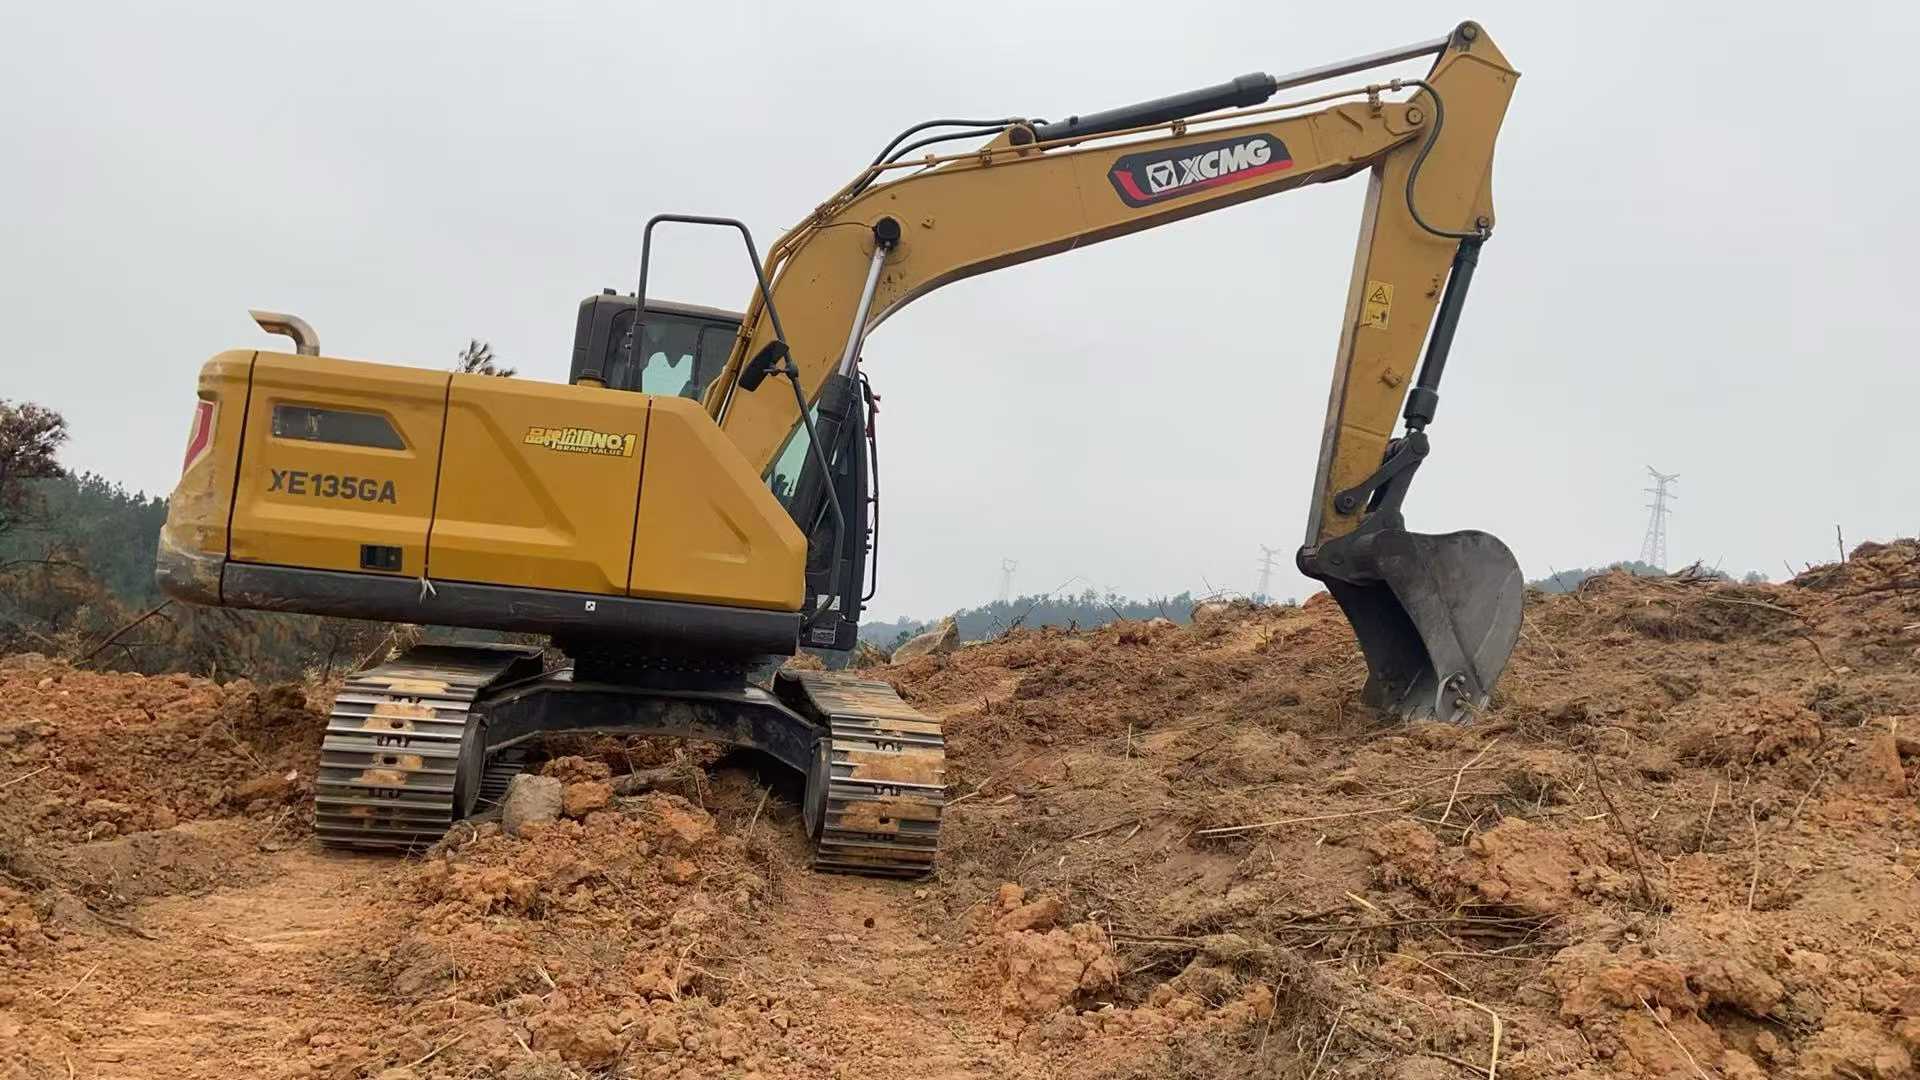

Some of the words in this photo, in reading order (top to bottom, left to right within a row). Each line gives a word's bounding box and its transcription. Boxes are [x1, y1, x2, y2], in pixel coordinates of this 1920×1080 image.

[1177, 139, 1272, 186] XCMG
[556, 444, 589, 454] BRAND
[592, 446, 623, 456] VALUE
[267, 468, 397, 504] XE135GA
